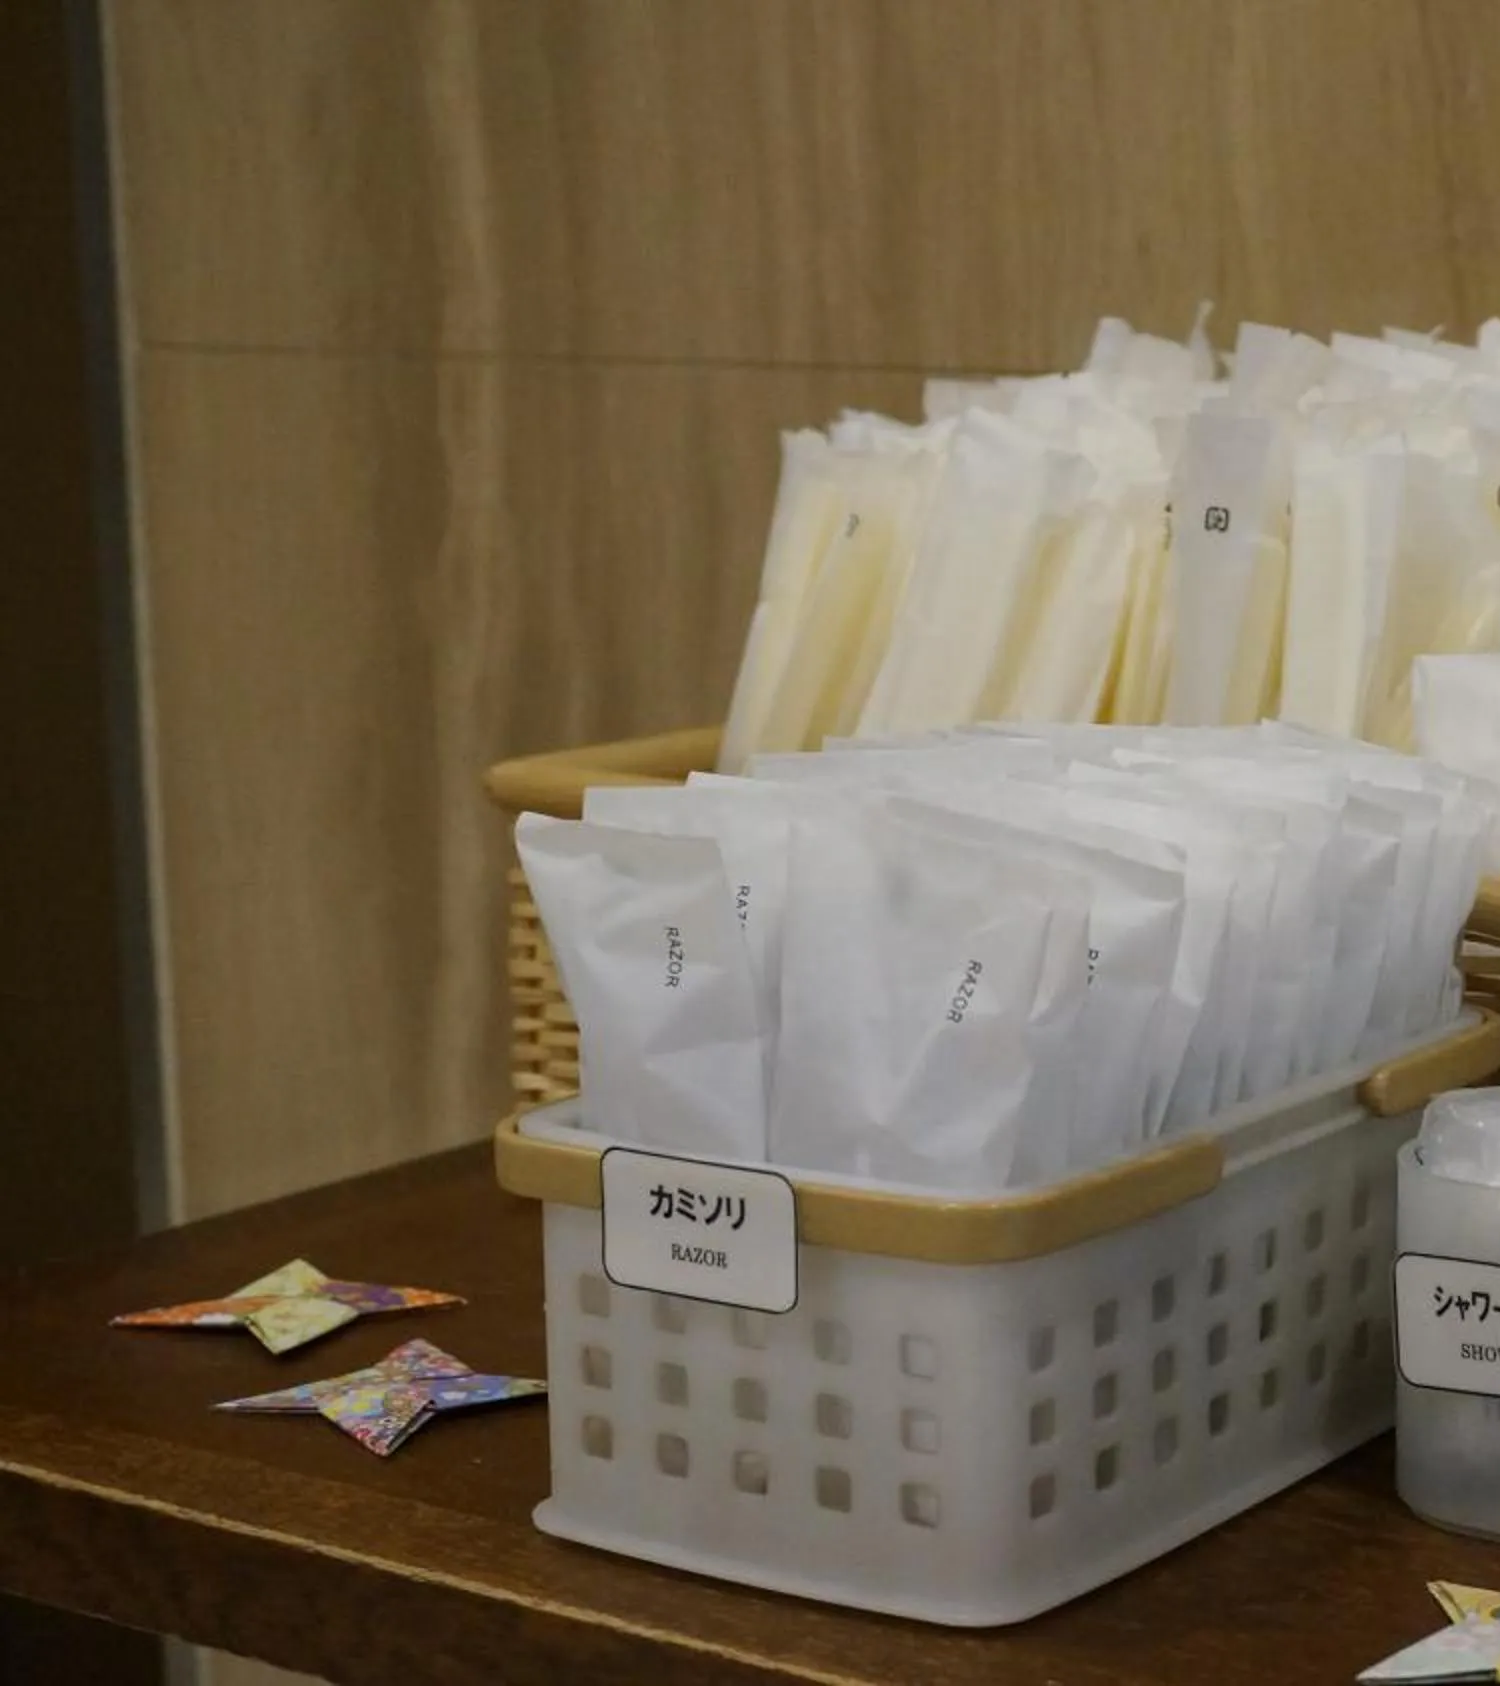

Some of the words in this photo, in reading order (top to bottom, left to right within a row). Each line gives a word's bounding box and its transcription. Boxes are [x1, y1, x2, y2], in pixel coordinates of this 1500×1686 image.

[664, 926, 684, 988] RAZOR
[946, 959, 983, 1024] RAZOR
[649, 1184, 746, 1231] カミソリ
[671, 1242, 728, 1269] RAZOR
